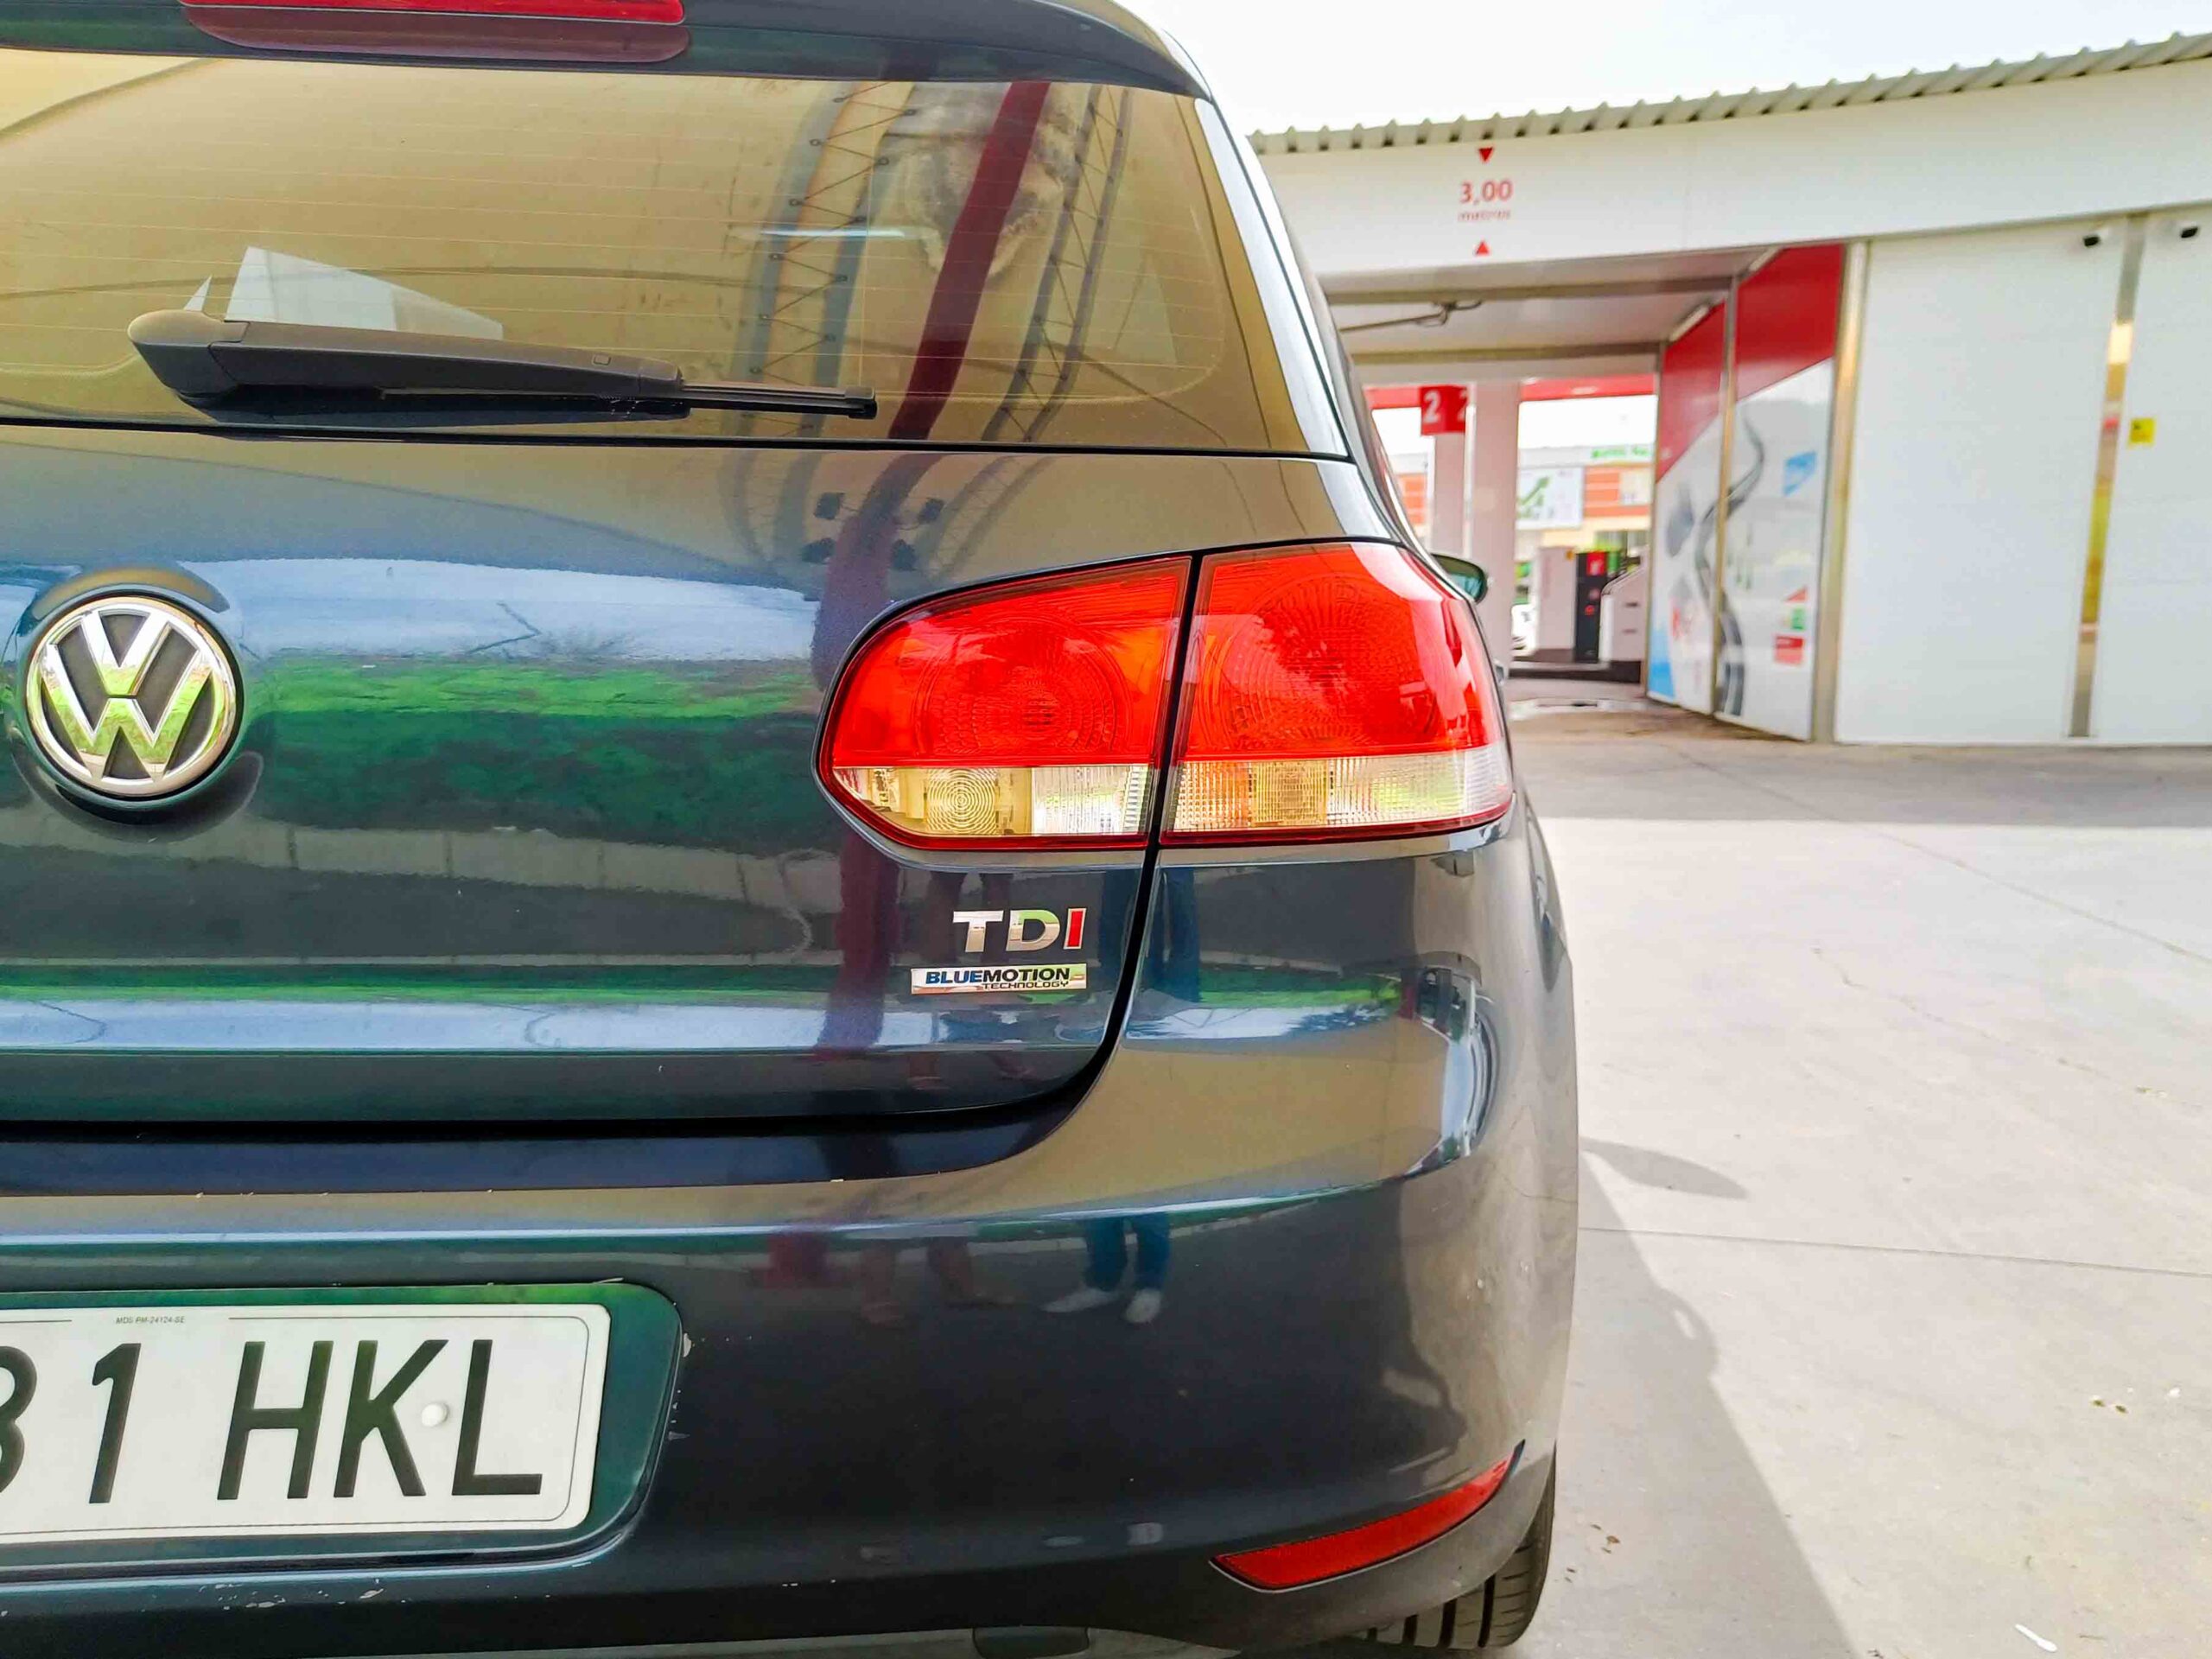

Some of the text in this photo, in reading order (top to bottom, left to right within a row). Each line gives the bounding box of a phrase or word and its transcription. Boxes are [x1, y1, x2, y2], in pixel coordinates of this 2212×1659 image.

[1459, 180, 1514, 206] 3,00
[1424, 390, 1440, 423] 2
[953, 908, 1087, 952] TDI
[925, 968, 1070, 984] BLUEMOTION
[982, 981, 1069, 990] TECHNOLOGY
[217, 1339, 543, 1500] HKL
